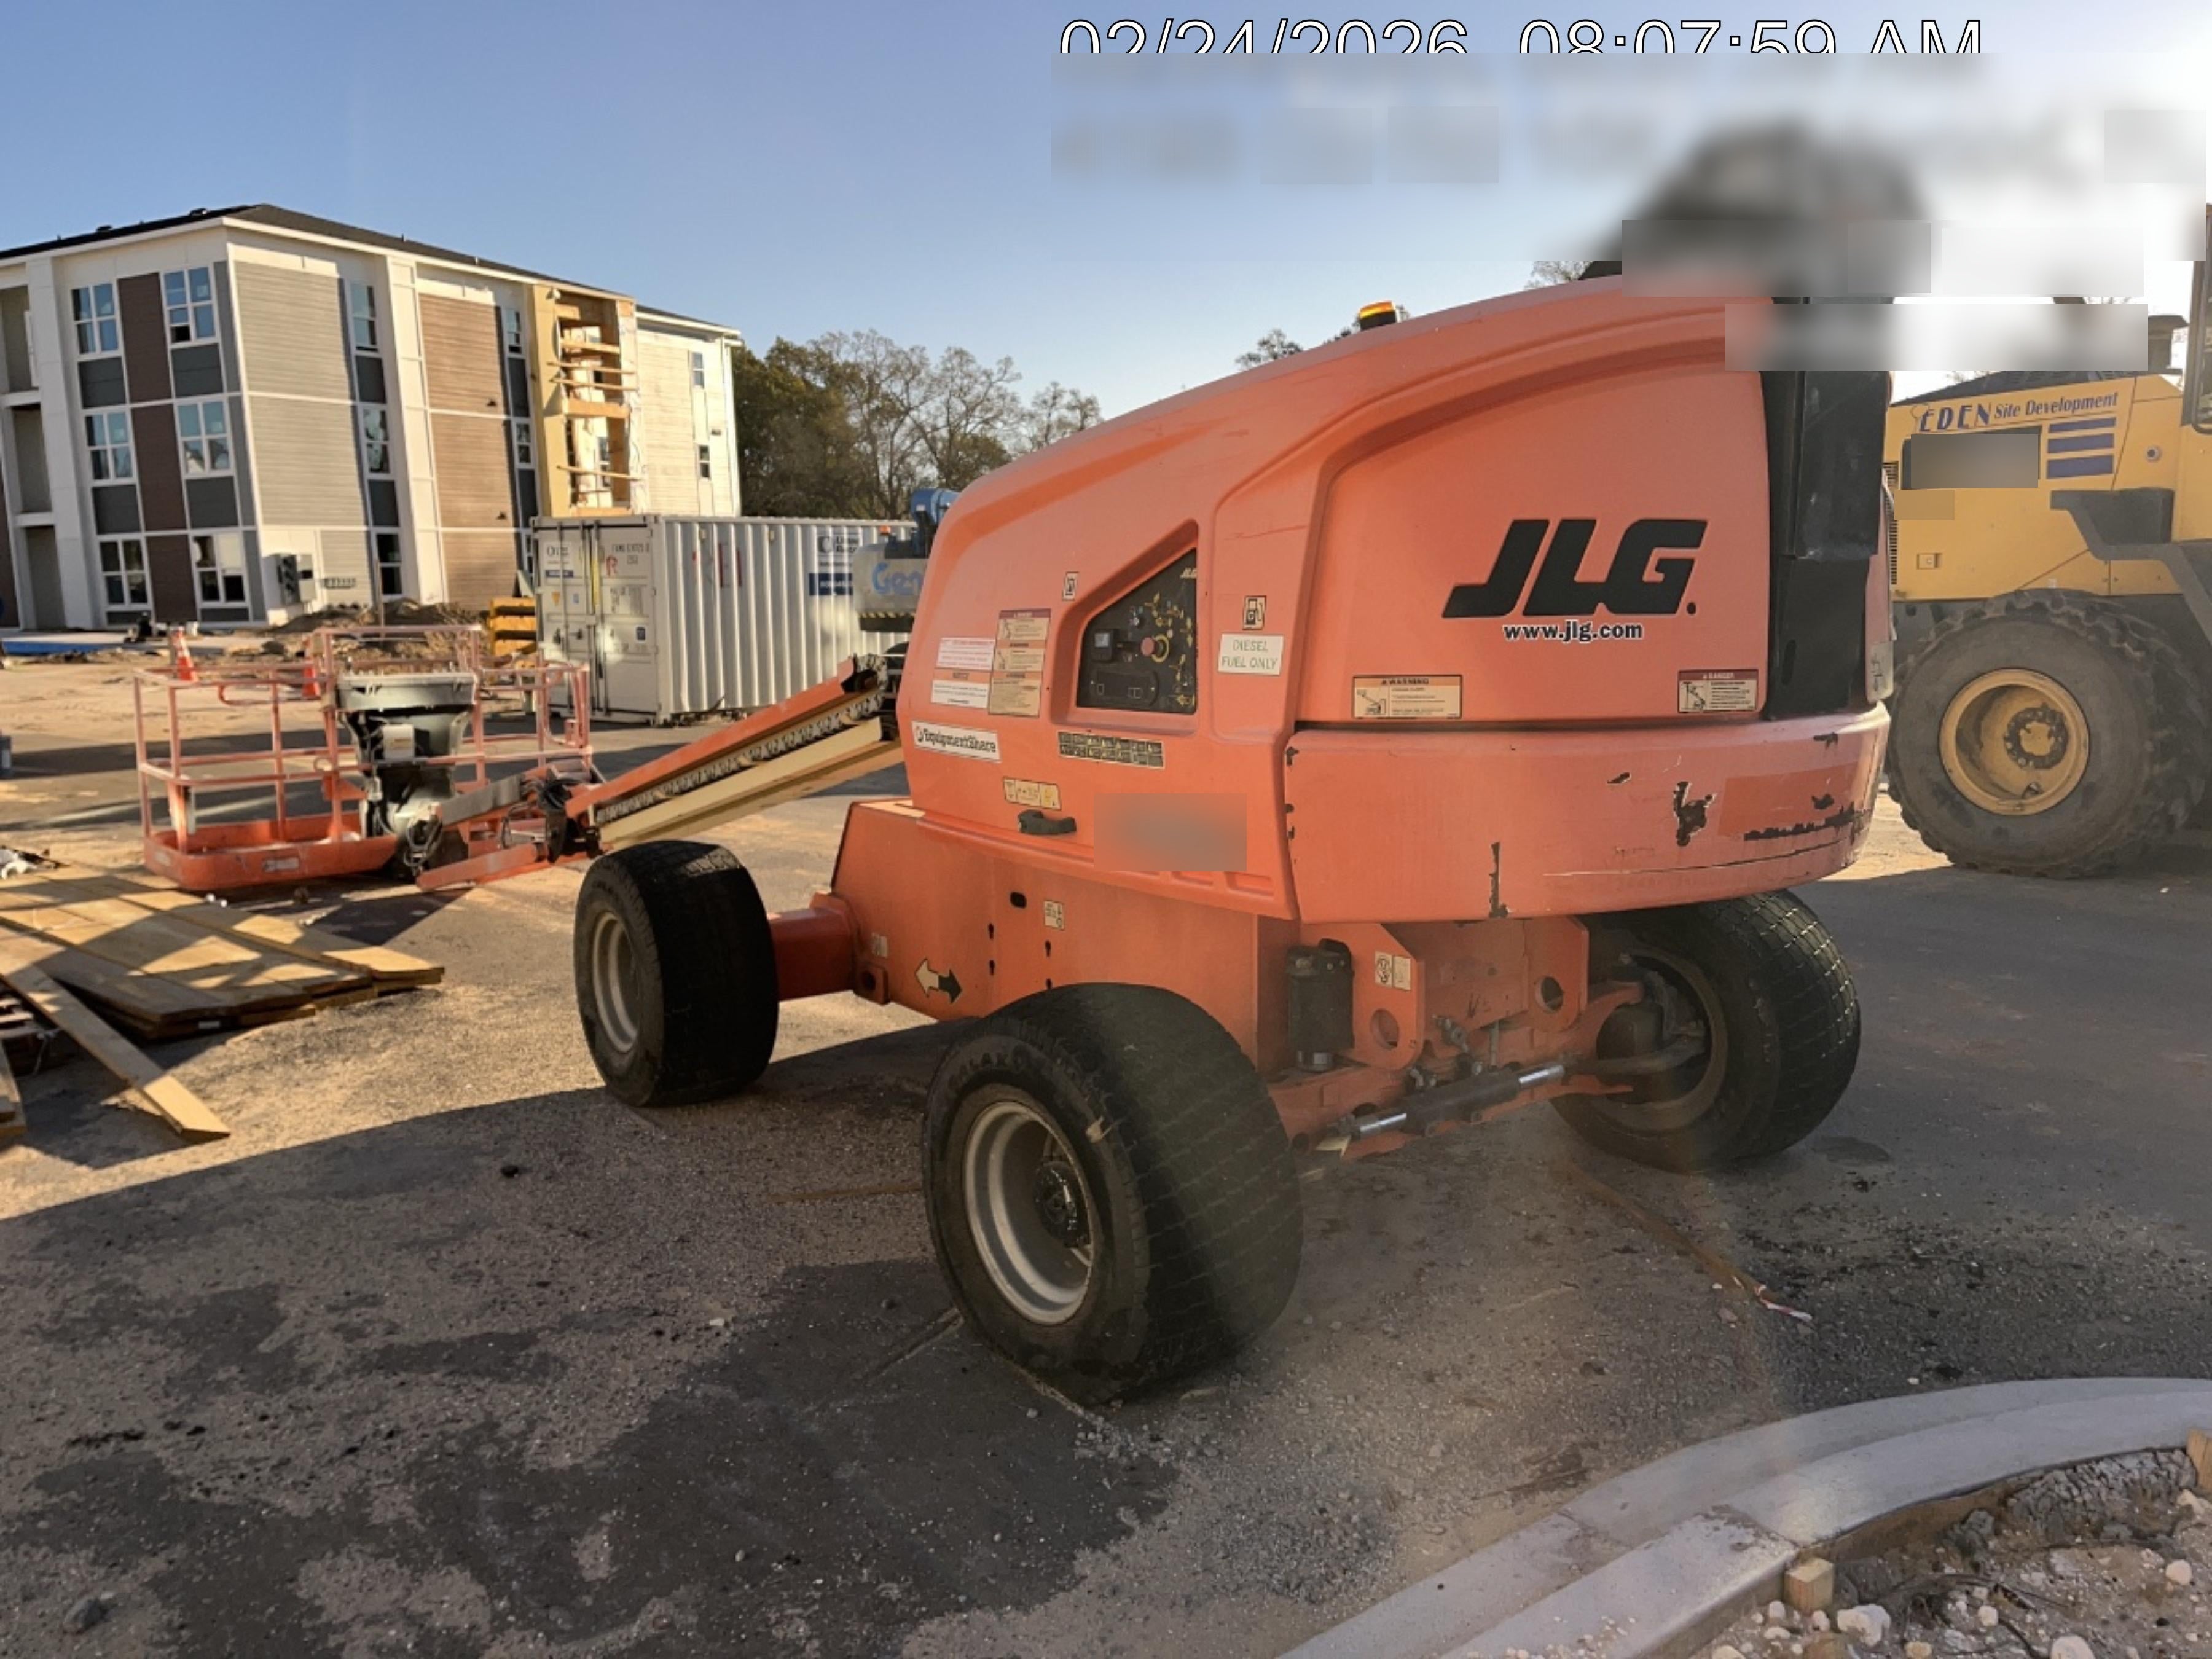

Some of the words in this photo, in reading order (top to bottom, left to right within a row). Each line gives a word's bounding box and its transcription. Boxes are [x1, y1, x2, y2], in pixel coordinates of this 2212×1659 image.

[1918, 402, 1991, 432] EDEN
[1994, 402, 2021, 419] Site
[2025, 392, 2119, 416] Development
[1443, 519, 1708, 619] JLG
[1503, 620, 1644, 643] www.jlg.com
[1233, 640, 1268, 651] DIESEL
[1222, 656, 1246, 668] FUEL
[1250, 656, 1278, 670] ONLY
